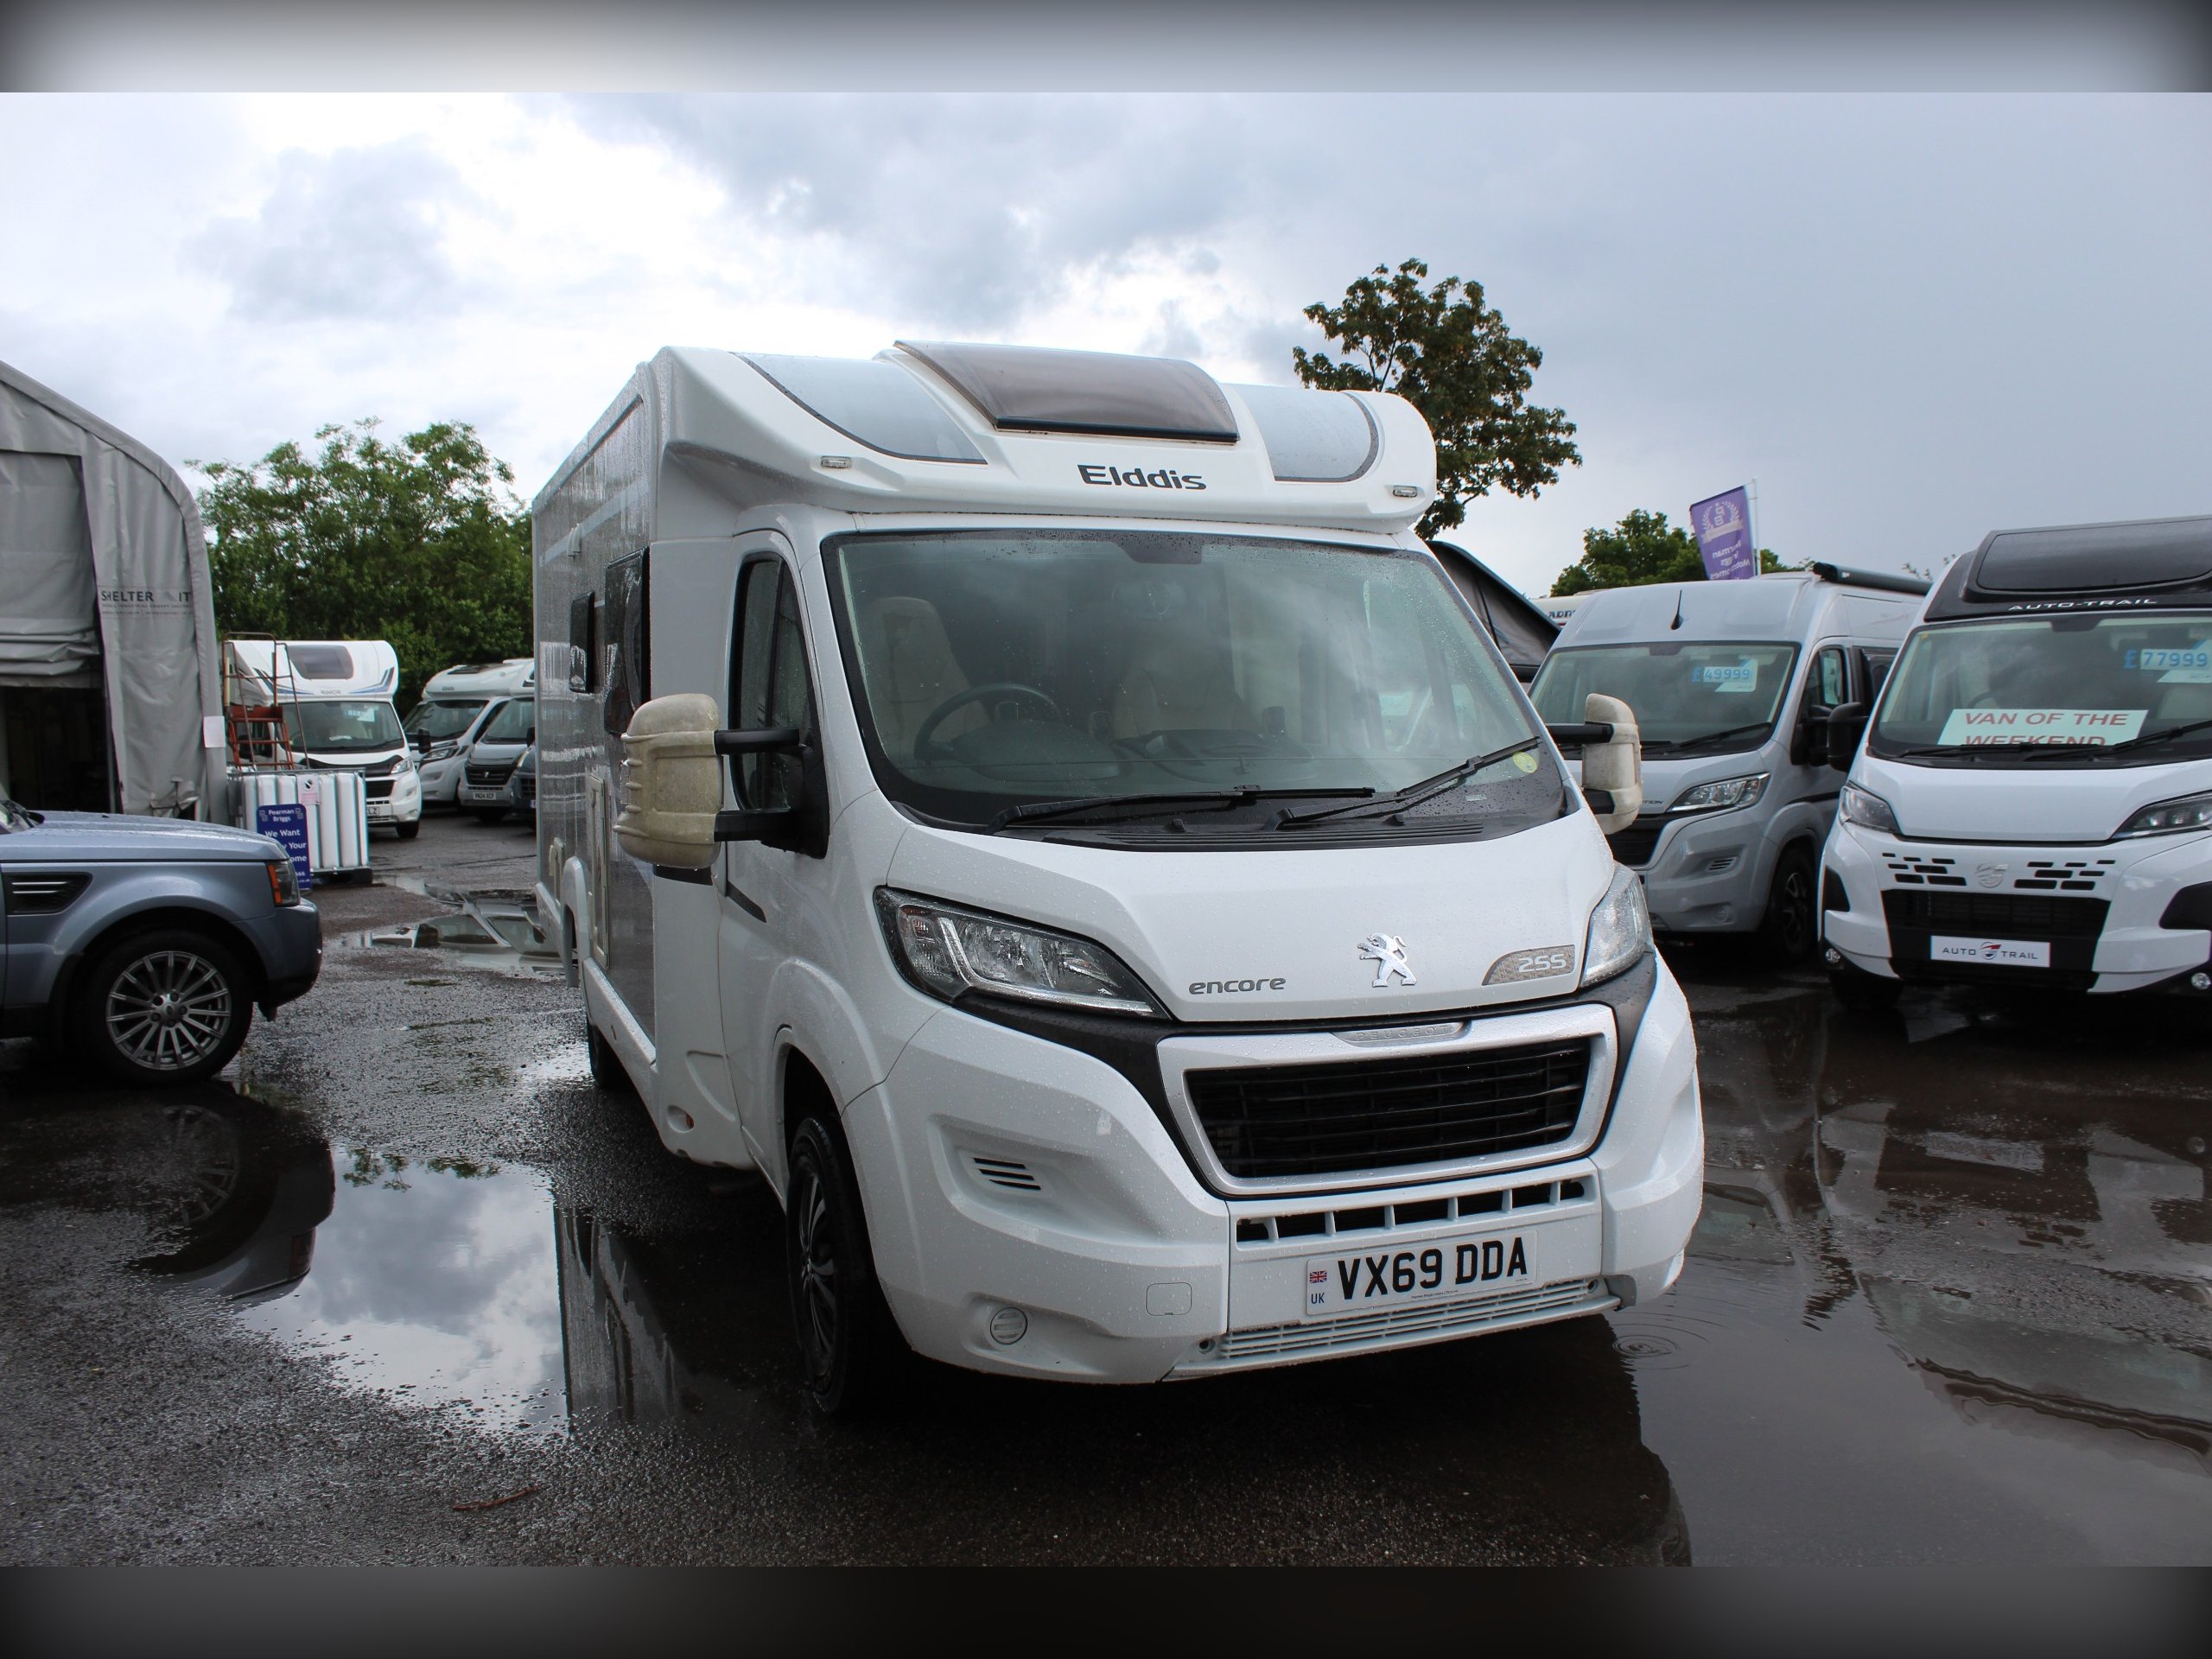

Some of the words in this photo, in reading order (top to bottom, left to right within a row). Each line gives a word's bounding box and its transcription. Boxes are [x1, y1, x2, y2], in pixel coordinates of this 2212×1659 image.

[1077, 464, 1207, 490] Elddis
[101, 590, 154, 601] SHELTER
[1965, 713, 2018, 725] VAN
[2025, 713, 2065, 725] OF
[2073, 713, 2130, 726] THE
[288, 842, 307, 850] Your
[1942, 947, 1976, 956] AUTO
[2001, 950, 2038, 959] TRAIL
[1518, 957, 1567, 974] 255
[1189, 977, 1287, 995] encore
[1311, 1293, 1325, 1304] UK
[1338, 1251, 1443, 1300] VX69
[1455, 1236, 1528, 1285] DDA
